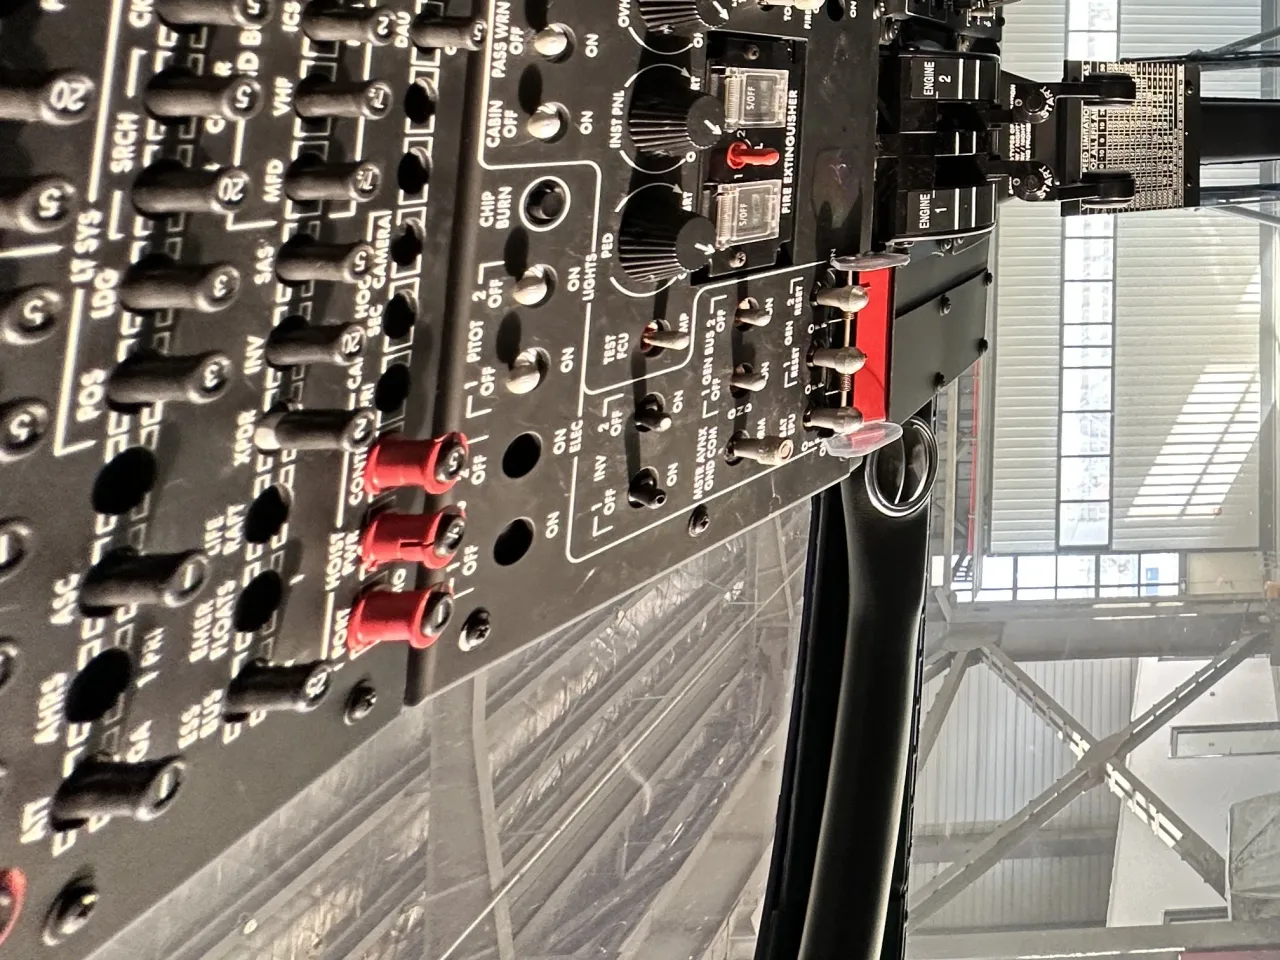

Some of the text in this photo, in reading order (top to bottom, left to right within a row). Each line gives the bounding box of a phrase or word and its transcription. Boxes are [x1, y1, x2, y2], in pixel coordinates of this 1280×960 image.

[282, 0, 301, 32] ICS
[850, 1, 858, 18] ON
[394, 12, 410, 48] DAU
[491, 1, 510, 78] PASS WRN
[510, 26, 524, 55] OFF
[585, 33, 598, 58] ON
[923, 61, 935, 96] ENGINE
[272, 76, 293, 116] VHF
[746, 86, 755, 110] S/OFF
[1038, 86, 1054, 118] START
[486, 100, 503, 148] CABIN
[503, 110, 517, 138] OFF
[580, 110, 594, 135] ON
[610, 90, 624, 148] INST PNL
[110, 112, 140, 173] SRCH
[782, 90, 798, 214] FIRE EXTINGUISHER
[264, 159, 284, 202] MFD
[1036, 165, 1053, 199] START
[480, 190, 495, 228] CHIP
[496, 186, 512, 229] BURN
[739, 203, 748, 226] S/OFF
[919, 194, 931, 228] ENGINE
[71, 208, 102, 283] LT SYS
[372, 216, 392, 289] CAMERA
[602, 232, 614, 258] PED
[254, 246, 275, 285] SAS
[567, 266, 580, 292] ON
[582, 253, 597, 302] LIGHTS
[91, 268, 120, 319] LDG
[490, 279, 503, 308] OFF
[794, 286, 804, 315] RESET
[367, 304, 383, 338] SEC
[716, 309, 726, 332] OFF
[784, 320, 794, 346] GEN
[244, 334, 264, 374] INV
[466, 320, 484, 362] PITOT
[603, 335, 617, 364] TEST
[616, 333, 629, 360] FCU
[702, 330, 715, 386] GEN BUS
[560, 348, 575, 373] ON
[791, 347, 800, 378] RESET
[76, 368, 106, 422] POS
[480, 366, 496, 396] OFF
[711, 378, 721, 402] OFF
[673, 390, 684, 412] ON
[232, 409, 256, 467] XPDR
[569, 420, 583, 453] ELEC
[609, 410, 623, 436] OFF
[553, 428, 568, 455] ON
[706, 426, 718, 490] GND COM
[472, 455, 486, 485] OFF
[594, 455, 606, 482] INV
[668, 462, 678, 486] ON
[693, 426, 708, 500] MSTR AVNX
[603, 489, 617, 515] OFF
[204, 516, 225, 556] LIFE
[223, 504, 246, 556] RAFT
[545, 511, 560, 538] ON
[325, 532, 345, 590] HOIST
[462, 544, 479, 576] OFF
[50, 574, 80, 625] ASC
[188, 600, 214, 663] EMER
[209, 580, 236, 660] FLOATS
[332, 608, 350, 659] PORT
[140, 627, 165, 667] PRI
[34, 672, 68, 744] AHRS
[178, 705, 200, 749] ESS
